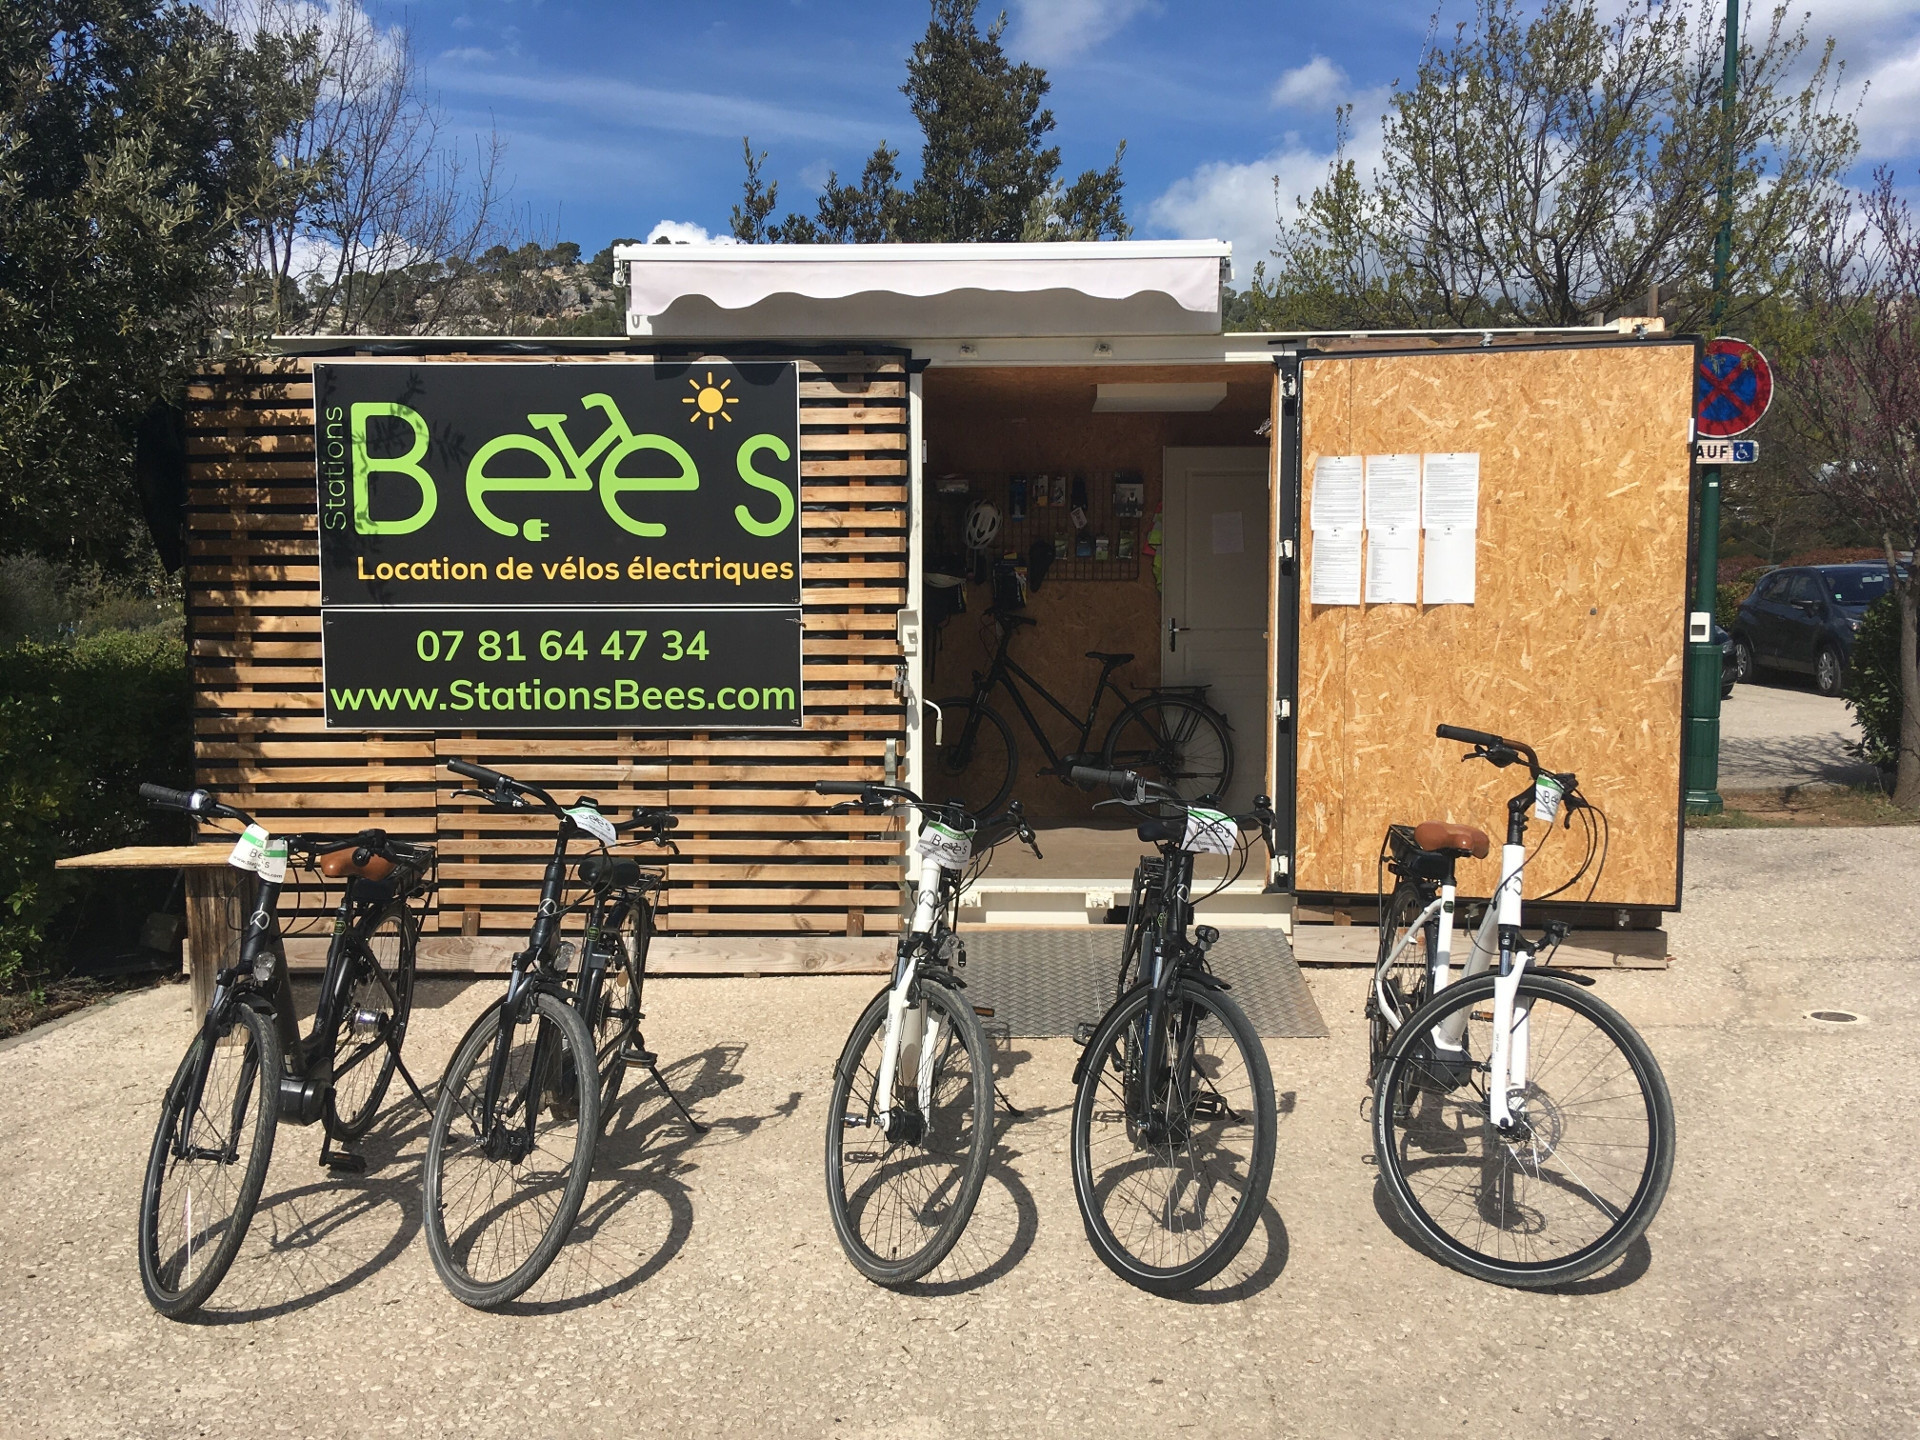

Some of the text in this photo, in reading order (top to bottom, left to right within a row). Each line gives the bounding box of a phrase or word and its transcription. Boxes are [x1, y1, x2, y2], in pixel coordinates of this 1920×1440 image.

[323, 406, 346, 530] Stations
[1696, 445, 1729, 459] AUF
[357, 555, 795, 586] Location de vélos électriques
[416, 630, 710, 662] 07 81 64 47 34
[330, 678, 796, 711] www.StationsBees.com
